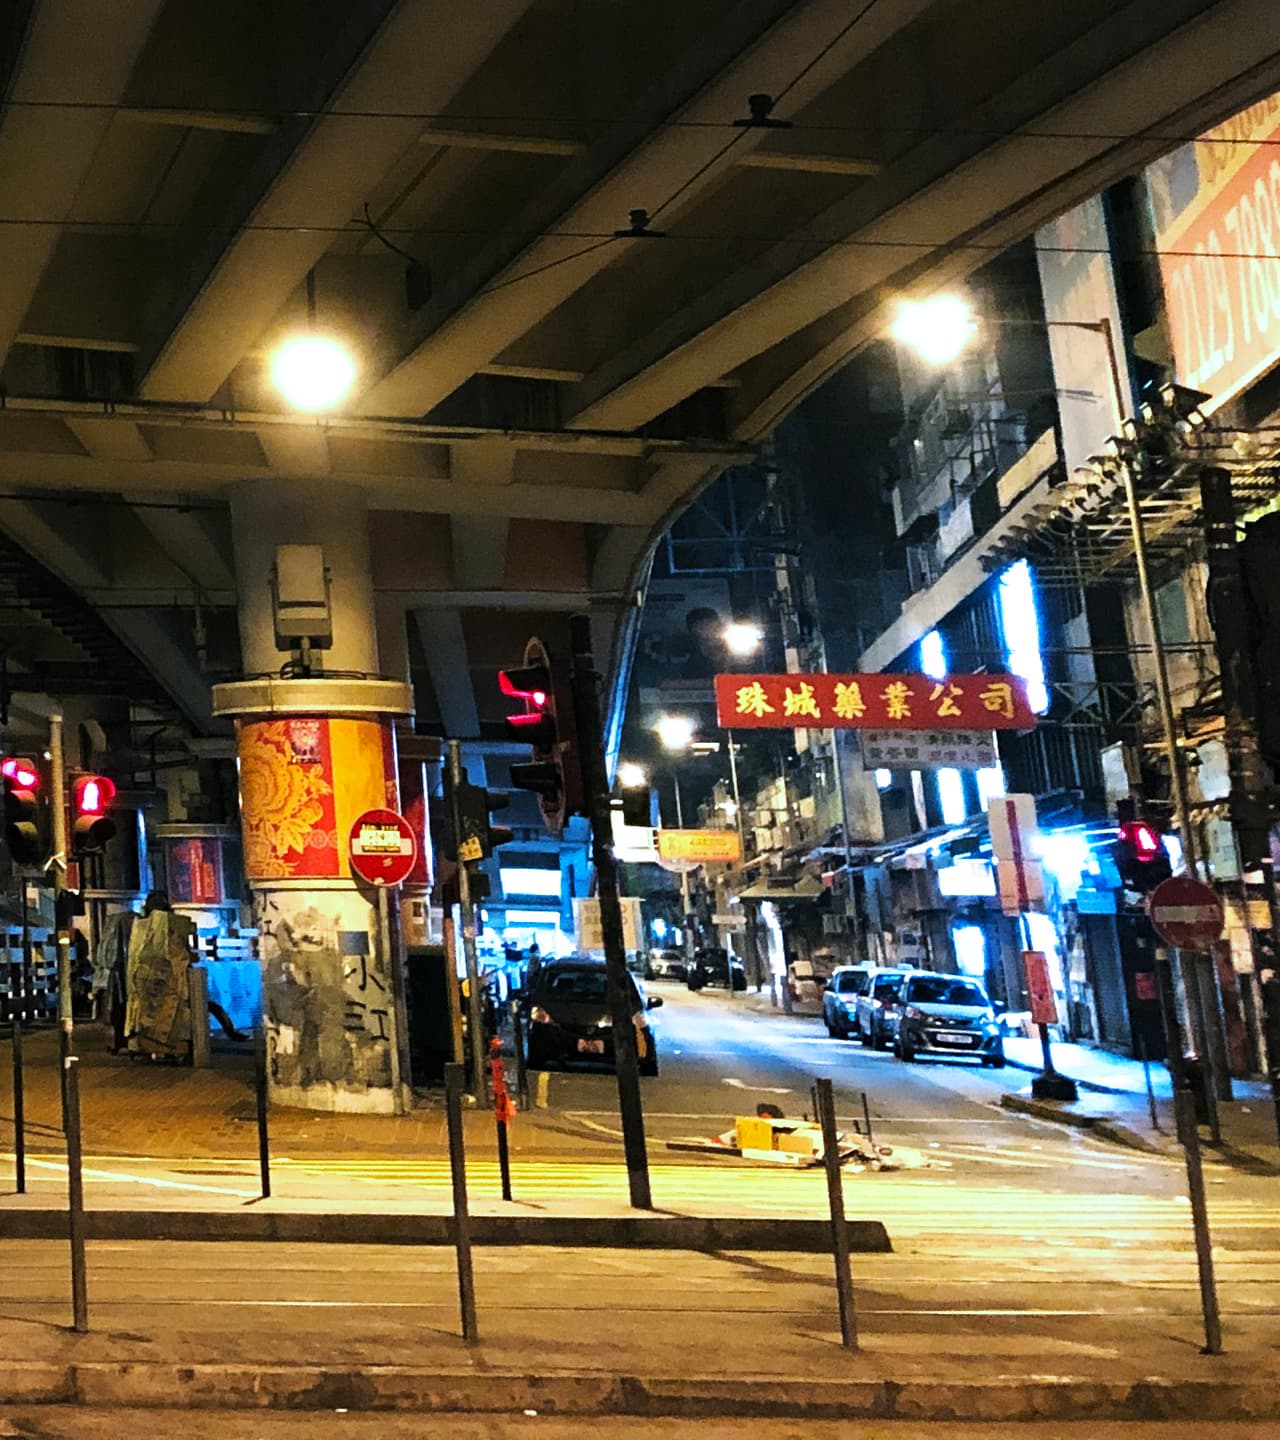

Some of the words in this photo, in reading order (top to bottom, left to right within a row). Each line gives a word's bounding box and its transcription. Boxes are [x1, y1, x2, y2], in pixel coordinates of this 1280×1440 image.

[736, 680, 1015, 720] 珠城藥業公司
